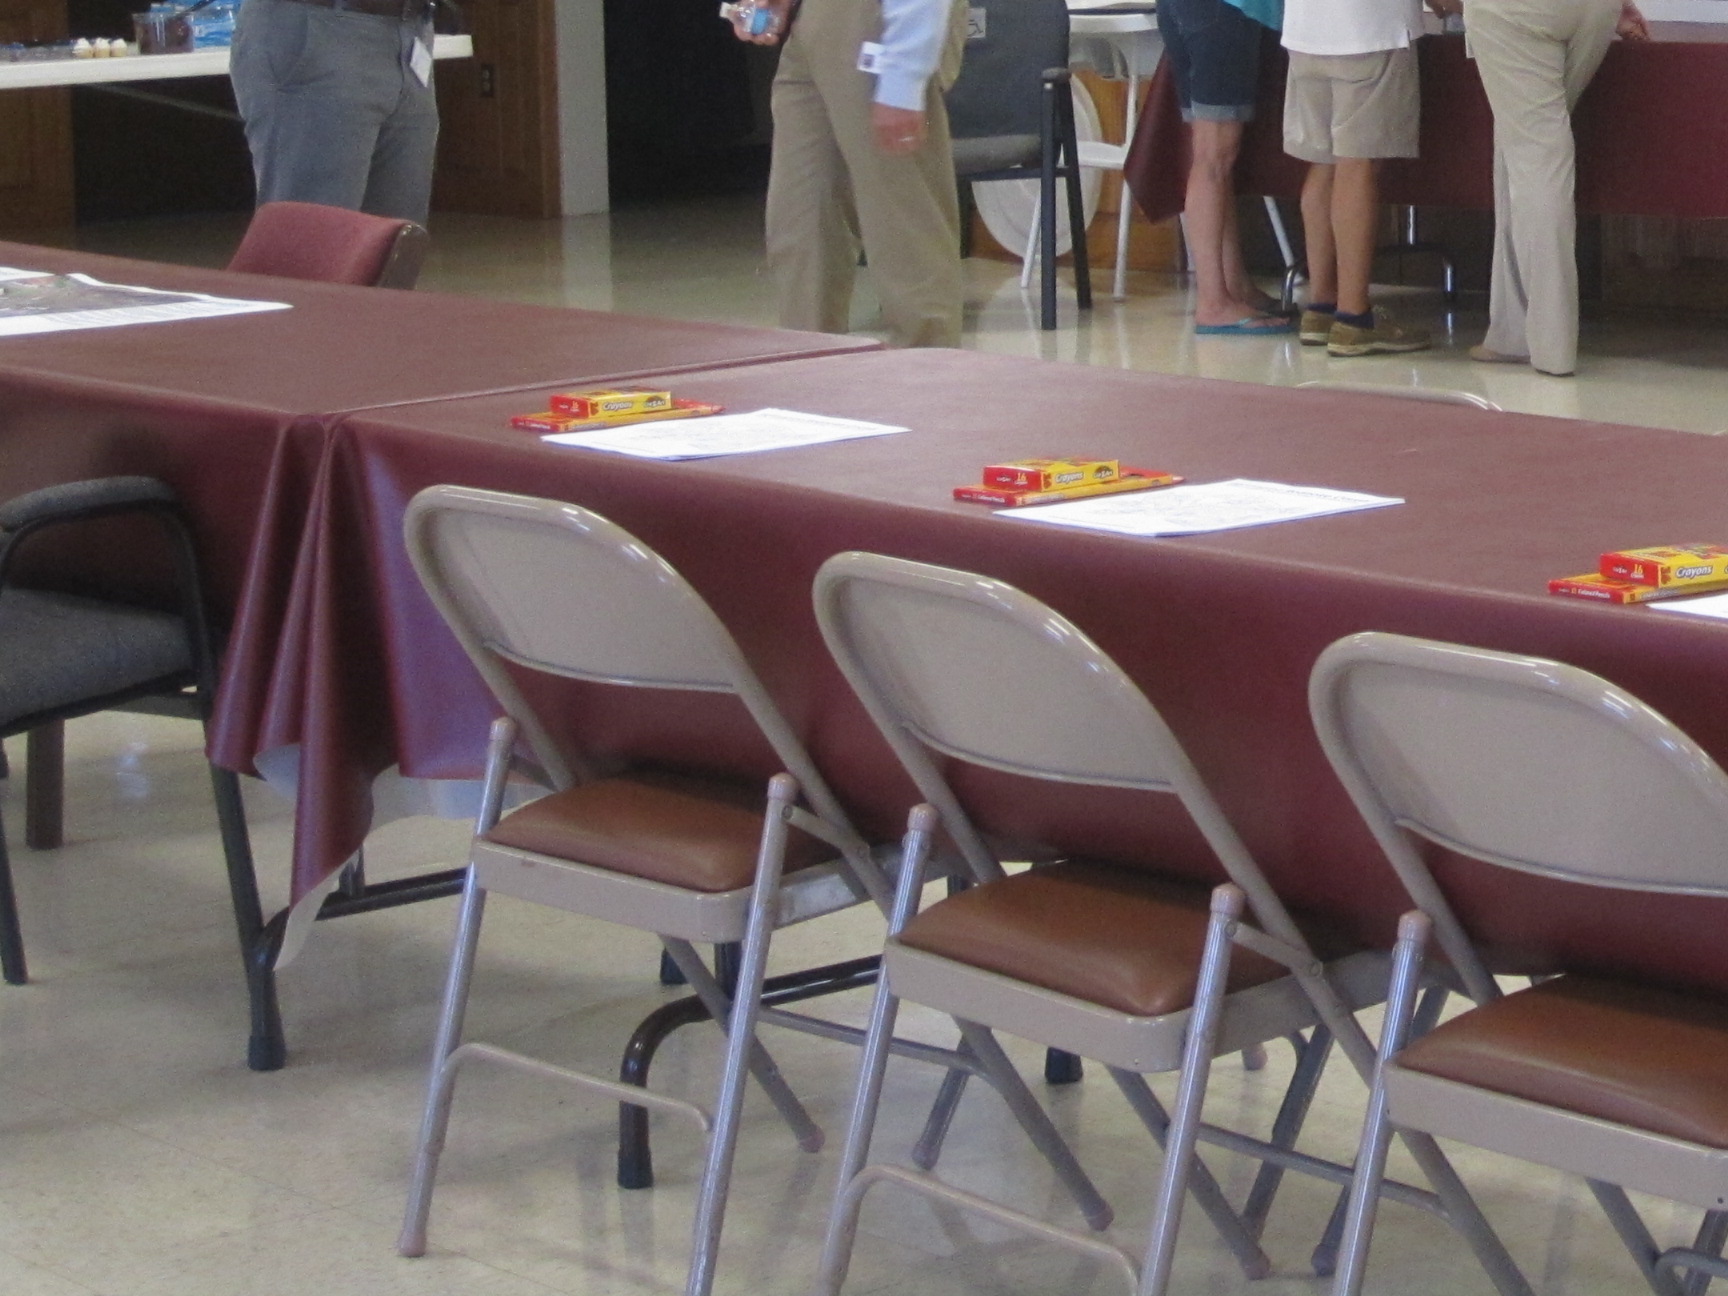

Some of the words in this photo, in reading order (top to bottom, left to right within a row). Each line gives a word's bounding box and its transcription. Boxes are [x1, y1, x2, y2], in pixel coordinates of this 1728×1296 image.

[1054, 471, 1085, 484] Crayons
[1633, 563, 1645, 574] 16
[1675, 565, 1714, 580] Crayons
